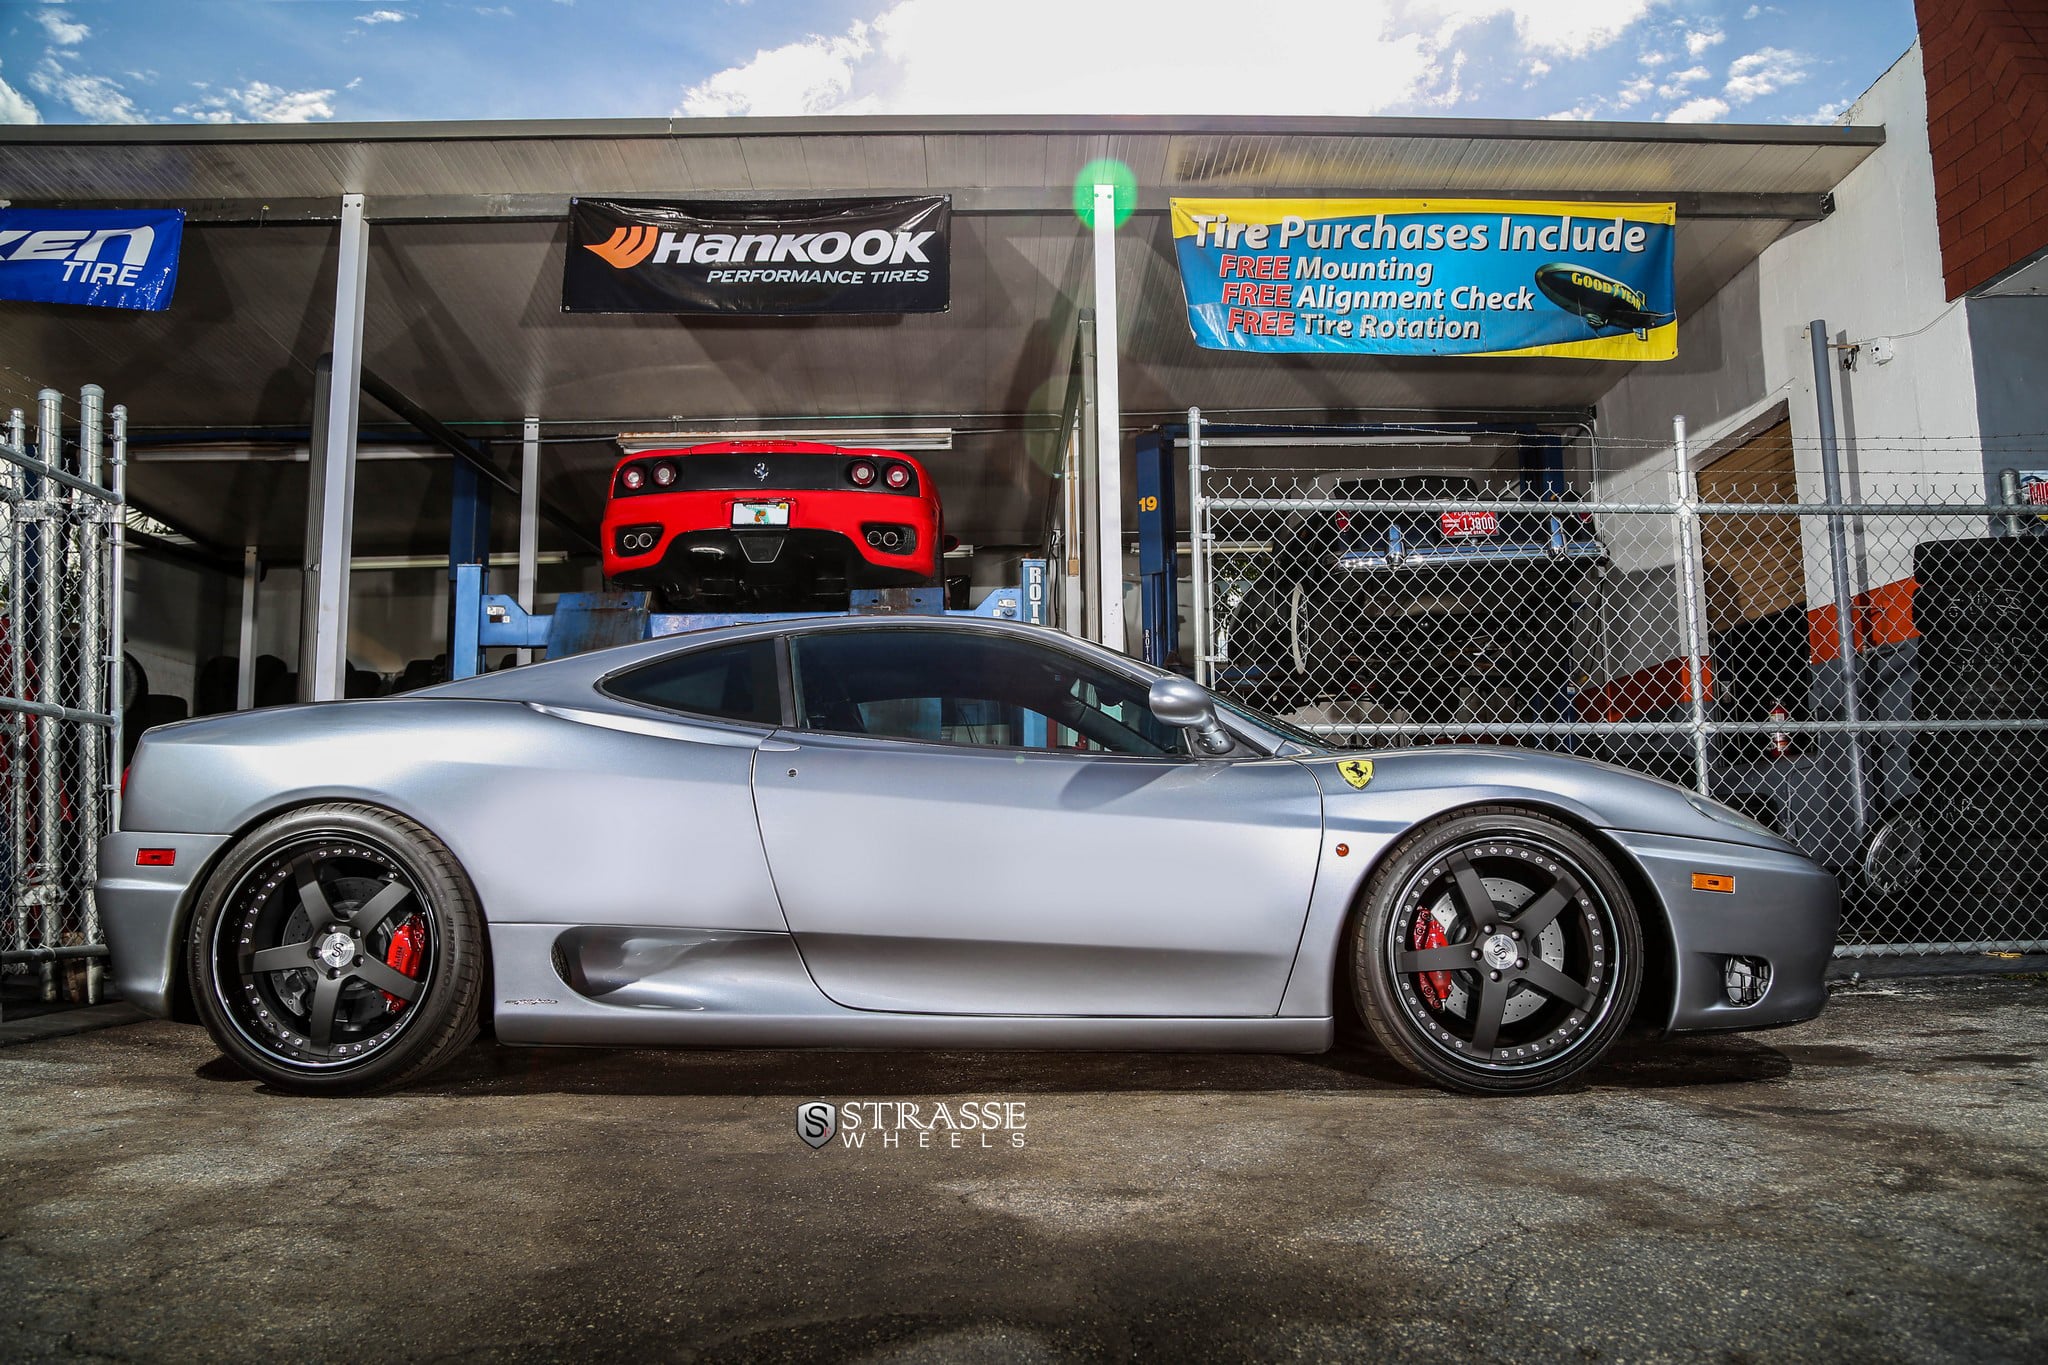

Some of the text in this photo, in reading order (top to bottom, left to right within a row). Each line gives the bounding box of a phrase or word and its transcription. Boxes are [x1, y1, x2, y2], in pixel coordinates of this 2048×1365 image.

[1191, 214, 1647, 252] Tire Purchases Include
[62, 261, 143, 286] TIRE
[706, 270, 929, 284] PERFORMANCE TIRES
[1219, 254, 1434, 286] FREE Mounting
[1221, 283, 1536, 315] FREE Alignment Check
[1571, 272, 1642, 311] GOODYEAR
[1227, 308, 1481, 340] FREE Tire Rotation
[1139, 495, 1158, 512] 19
